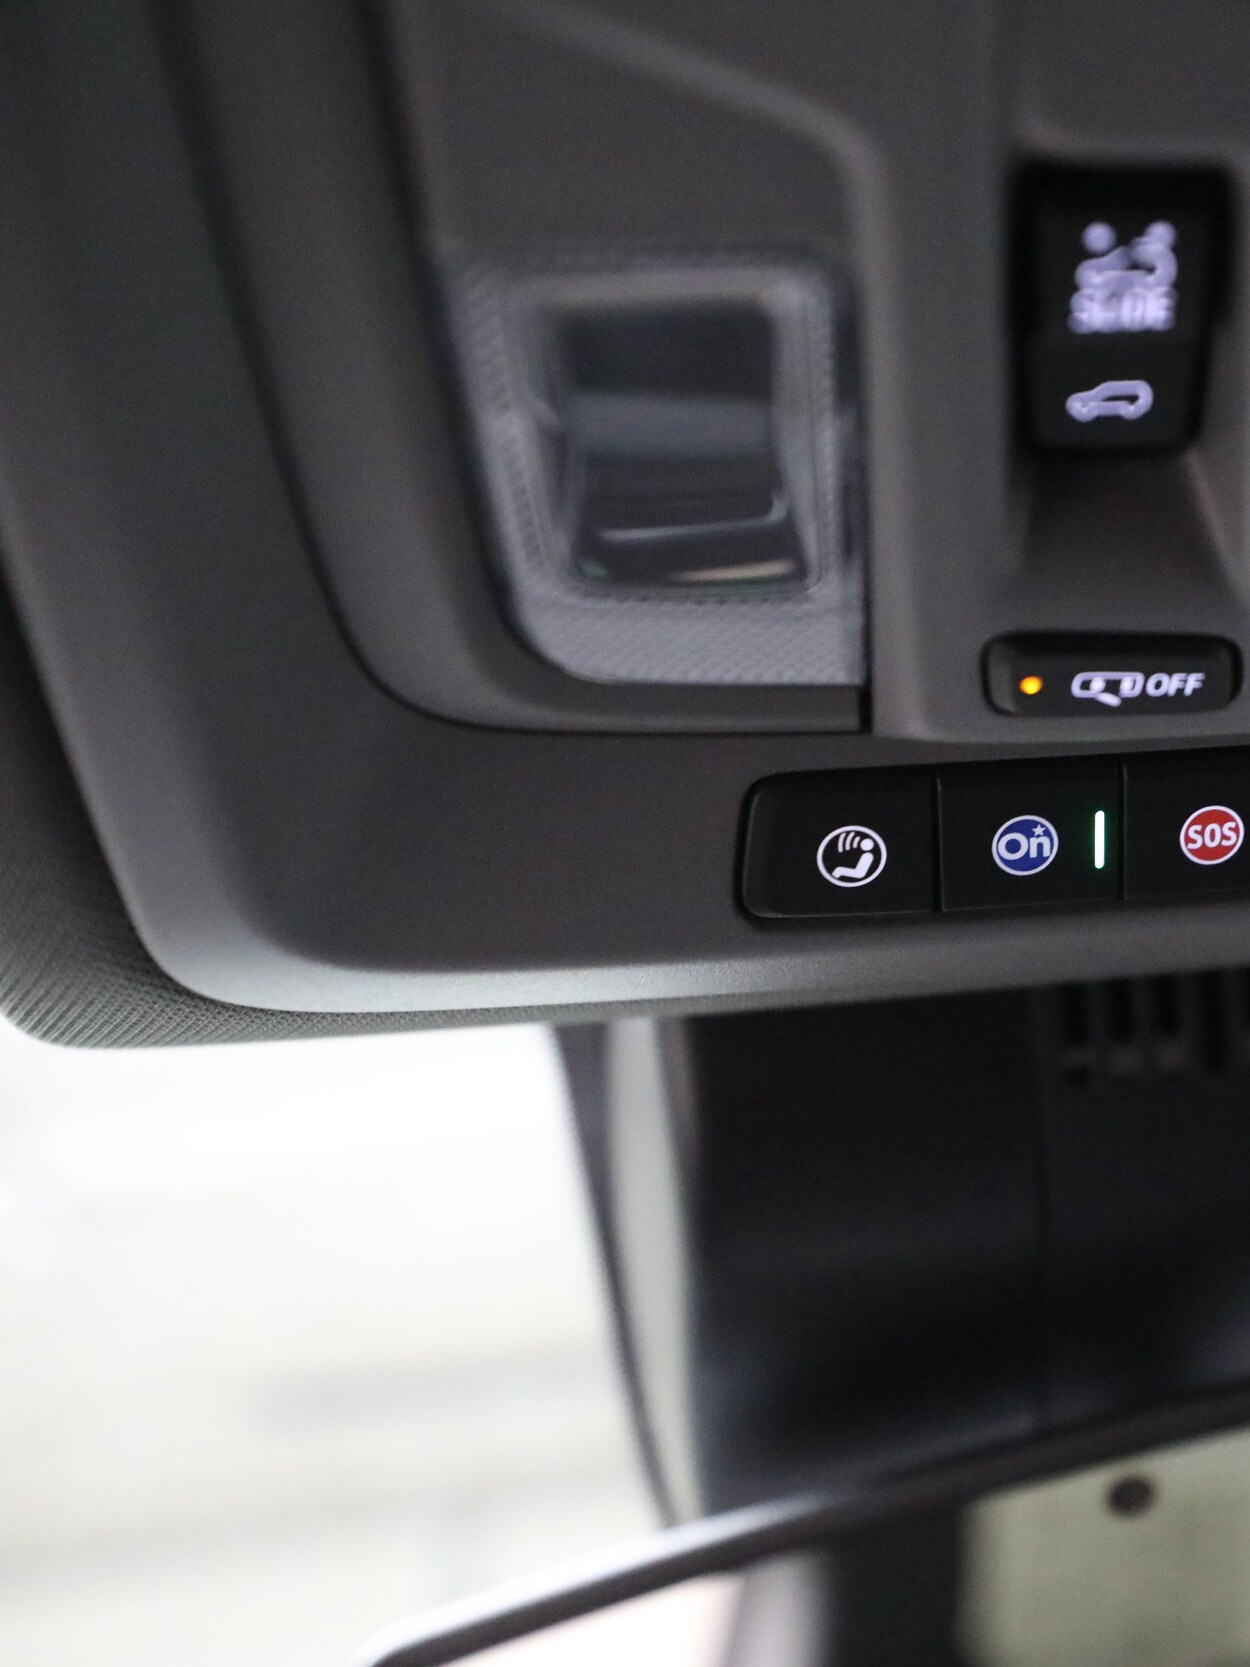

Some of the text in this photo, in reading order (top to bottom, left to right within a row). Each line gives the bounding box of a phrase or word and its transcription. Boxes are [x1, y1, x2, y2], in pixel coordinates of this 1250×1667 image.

[1145, 672, 1206, 698] OFF
[997, 831, 1051, 861] On
[1187, 821, 1238, 850] SOS
